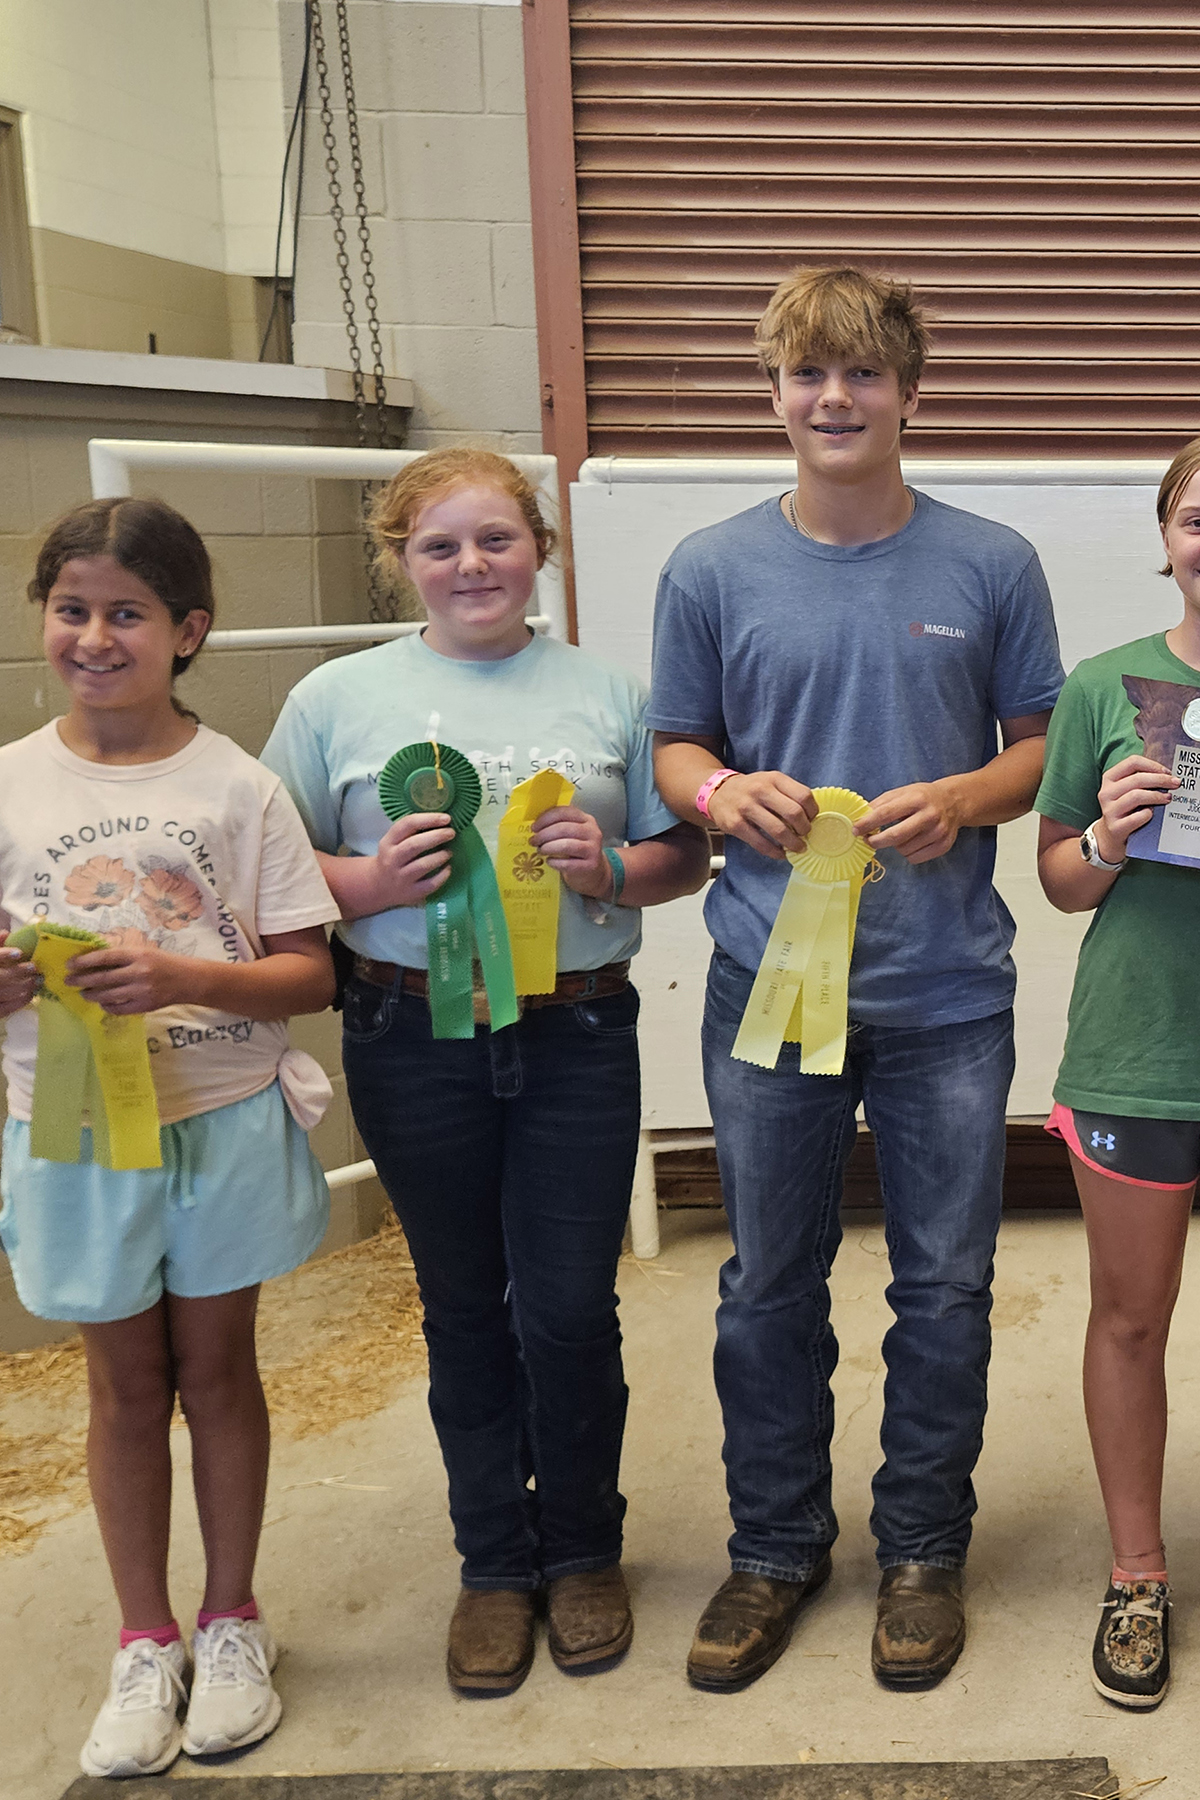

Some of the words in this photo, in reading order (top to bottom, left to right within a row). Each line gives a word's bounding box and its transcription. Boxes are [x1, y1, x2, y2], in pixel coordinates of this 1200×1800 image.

[923, 624, 966, 639] MAGELLAN
[1180, 778, 1196, 791] AIR
[1173, 795, 1198, 805] SHOW-ME
[33, 872, 51, 916] OES
[45, 816, 149, 864] AROUND
[762, 981, 779, 1016] MISSOURI
[775, 960, 787, 976] TATE
[781, 940, 793, 957] FAIR
[167, 1020, 255, 1050] Energy
